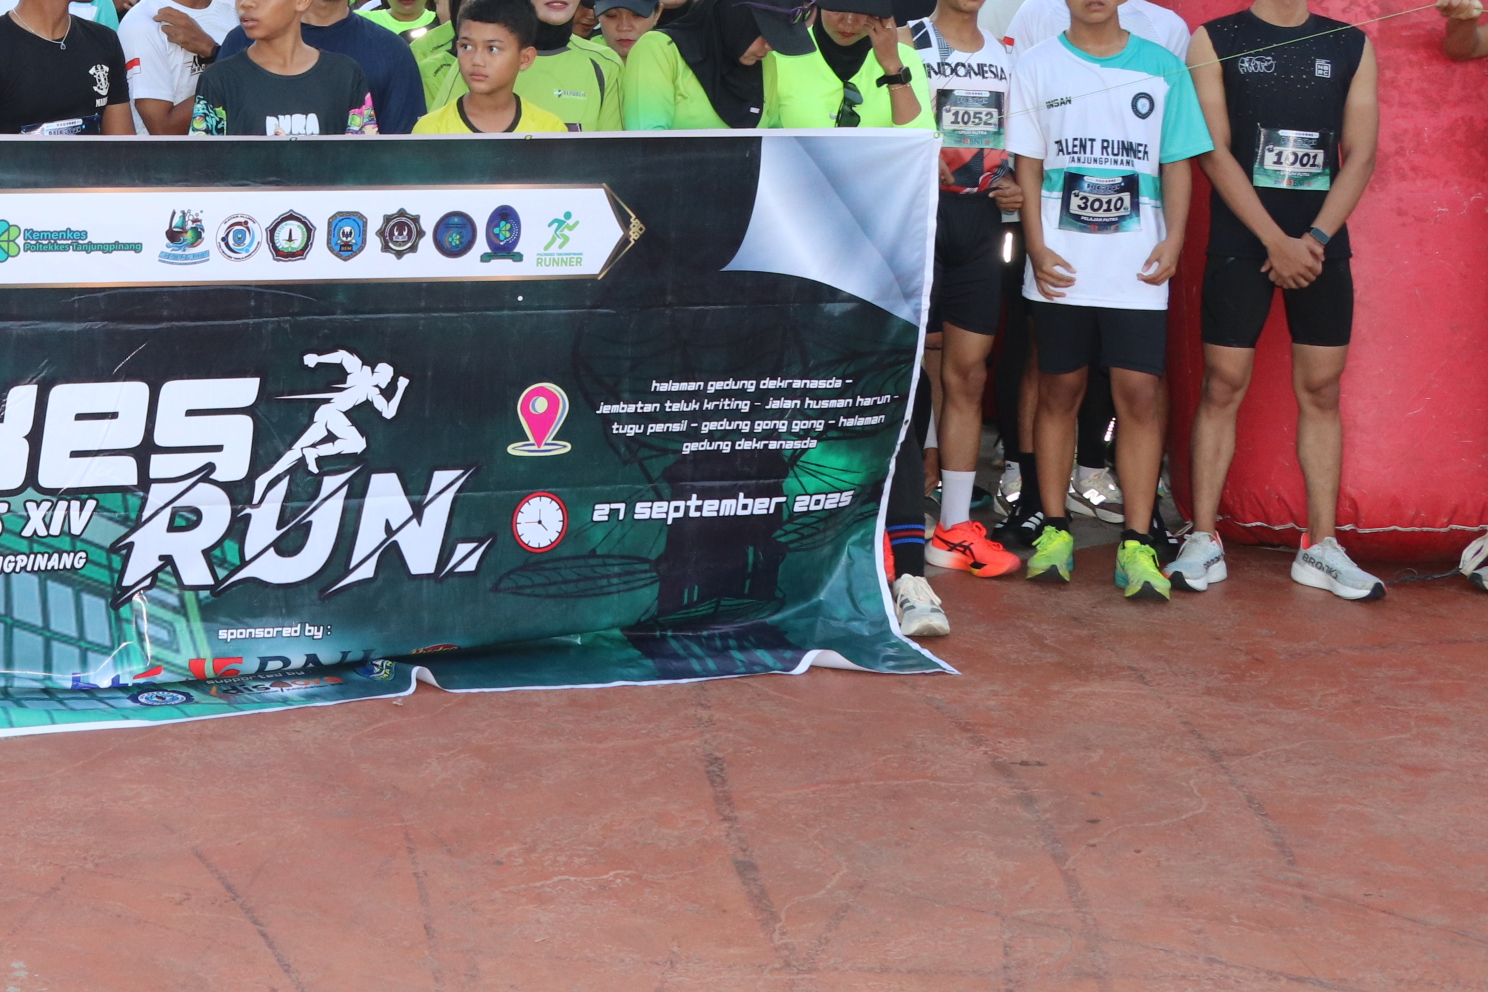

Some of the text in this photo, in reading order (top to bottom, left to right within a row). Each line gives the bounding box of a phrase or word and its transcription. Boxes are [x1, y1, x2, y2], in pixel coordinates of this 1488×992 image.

[1045, 96, 1072, 109] INSAN
[950, 110, 994, 126] 1052
[1054, 137, 1150, 161] TALENT RUNNER
[1272, 150, 1318, 168] 1001
[1076, 195, 1125, 213] 3010
[24, 229, 87, 241] Kemenkes
[24, 242, 142, 253] Poltekkes Tanjungpinang
[536, 257, 583, 267] RUNNER
[651, 379, 704, 392] halaman
[706, 378, 756, 394] gedung
[759, 377, 842, 390] dekranasda
[596, 401, 660, 414] jembatan
[664, 399, 700, 412] teluk
[703, 398, 751, 413] kriting
[765, 397, 801, 410] jalan
[804, 396, 853, 409] husman
[855, 394, 891, 407] harun
[612, 421, 645, 437] tugu
[647, 420, 688, 436] pensil
[701, 419, 752, 433] gedung
[753, 419, 788, 433] gong
[791, 418, 825, 432] gong
[838, 413, 885, 428] halaman
[682, 437, 818, 454] gedung dekranasda
[592, 489, 855, 525] 27 september 2025
[20, 499, 97, 537] XIV
[218, 624, 302, 642] sponsored
